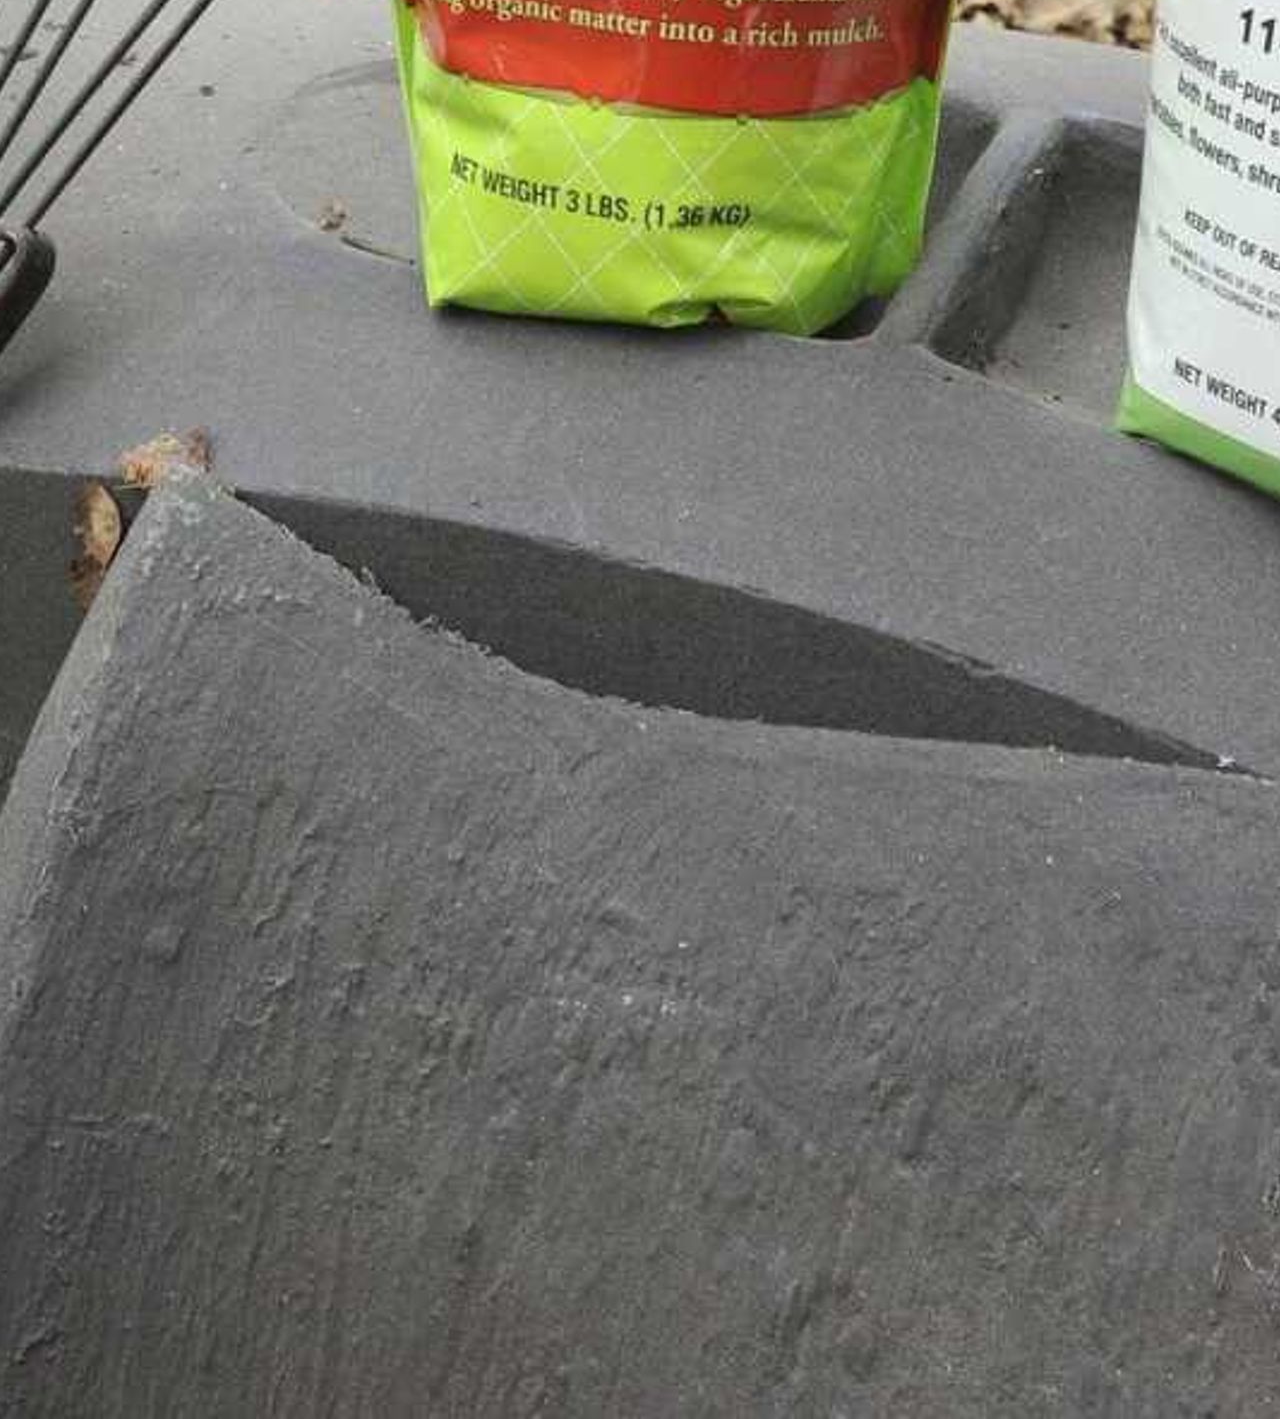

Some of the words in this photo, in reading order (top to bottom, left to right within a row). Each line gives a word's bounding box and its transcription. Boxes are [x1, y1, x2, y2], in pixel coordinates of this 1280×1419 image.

[568, 6, 651, 37] matter
[658, 13, 715, 43] into
[722, 26, 739, 45] a
[747, 19, 797, 48] rich
[807, 15, 886, 47] mulch.
[1204, 91, 1232, 124] fast
[1234, 112, 1265, 140] and
[450, 151, 478, 182] NET
[481, 169, 561, 209] WEIGHT
[565, 189, 580, 214] 3
[586, 192, 636, 223] LBS.
[709, 202, 752, 229] KG)
[1213, 225, 1237, 250] OUT
[1240, 238, 1257, 257] OF
[1175, 356, 1202, 388] NET
[1206, 373, 1268, 418] WEIGHT
